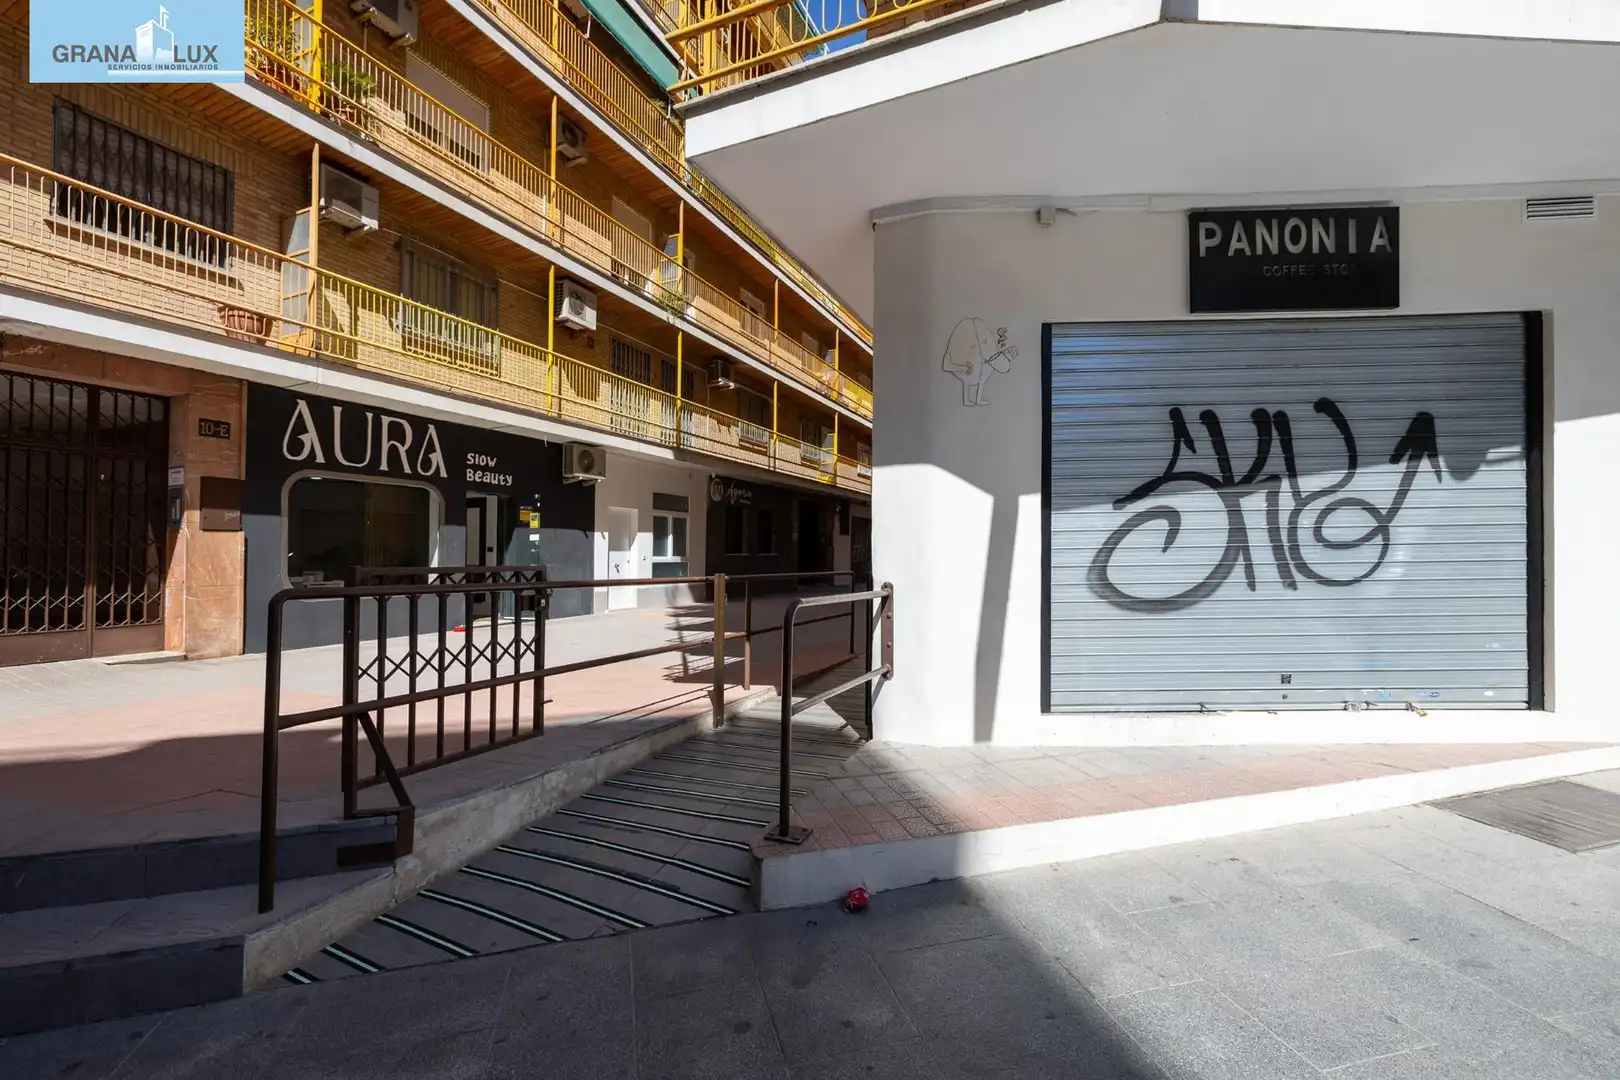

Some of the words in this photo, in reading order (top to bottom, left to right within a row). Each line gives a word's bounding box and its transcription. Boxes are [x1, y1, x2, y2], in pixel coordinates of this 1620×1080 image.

[1199, 216, 1392, 257] PANONIA
[1262, 263, 1317, 277] COFFEE
[200, 421, 229, 437] 10-E
[282, 398, 448, 478] AURA
[466, 452, 497, 468] Slow
[466, 468, 513, 487] Beauty
